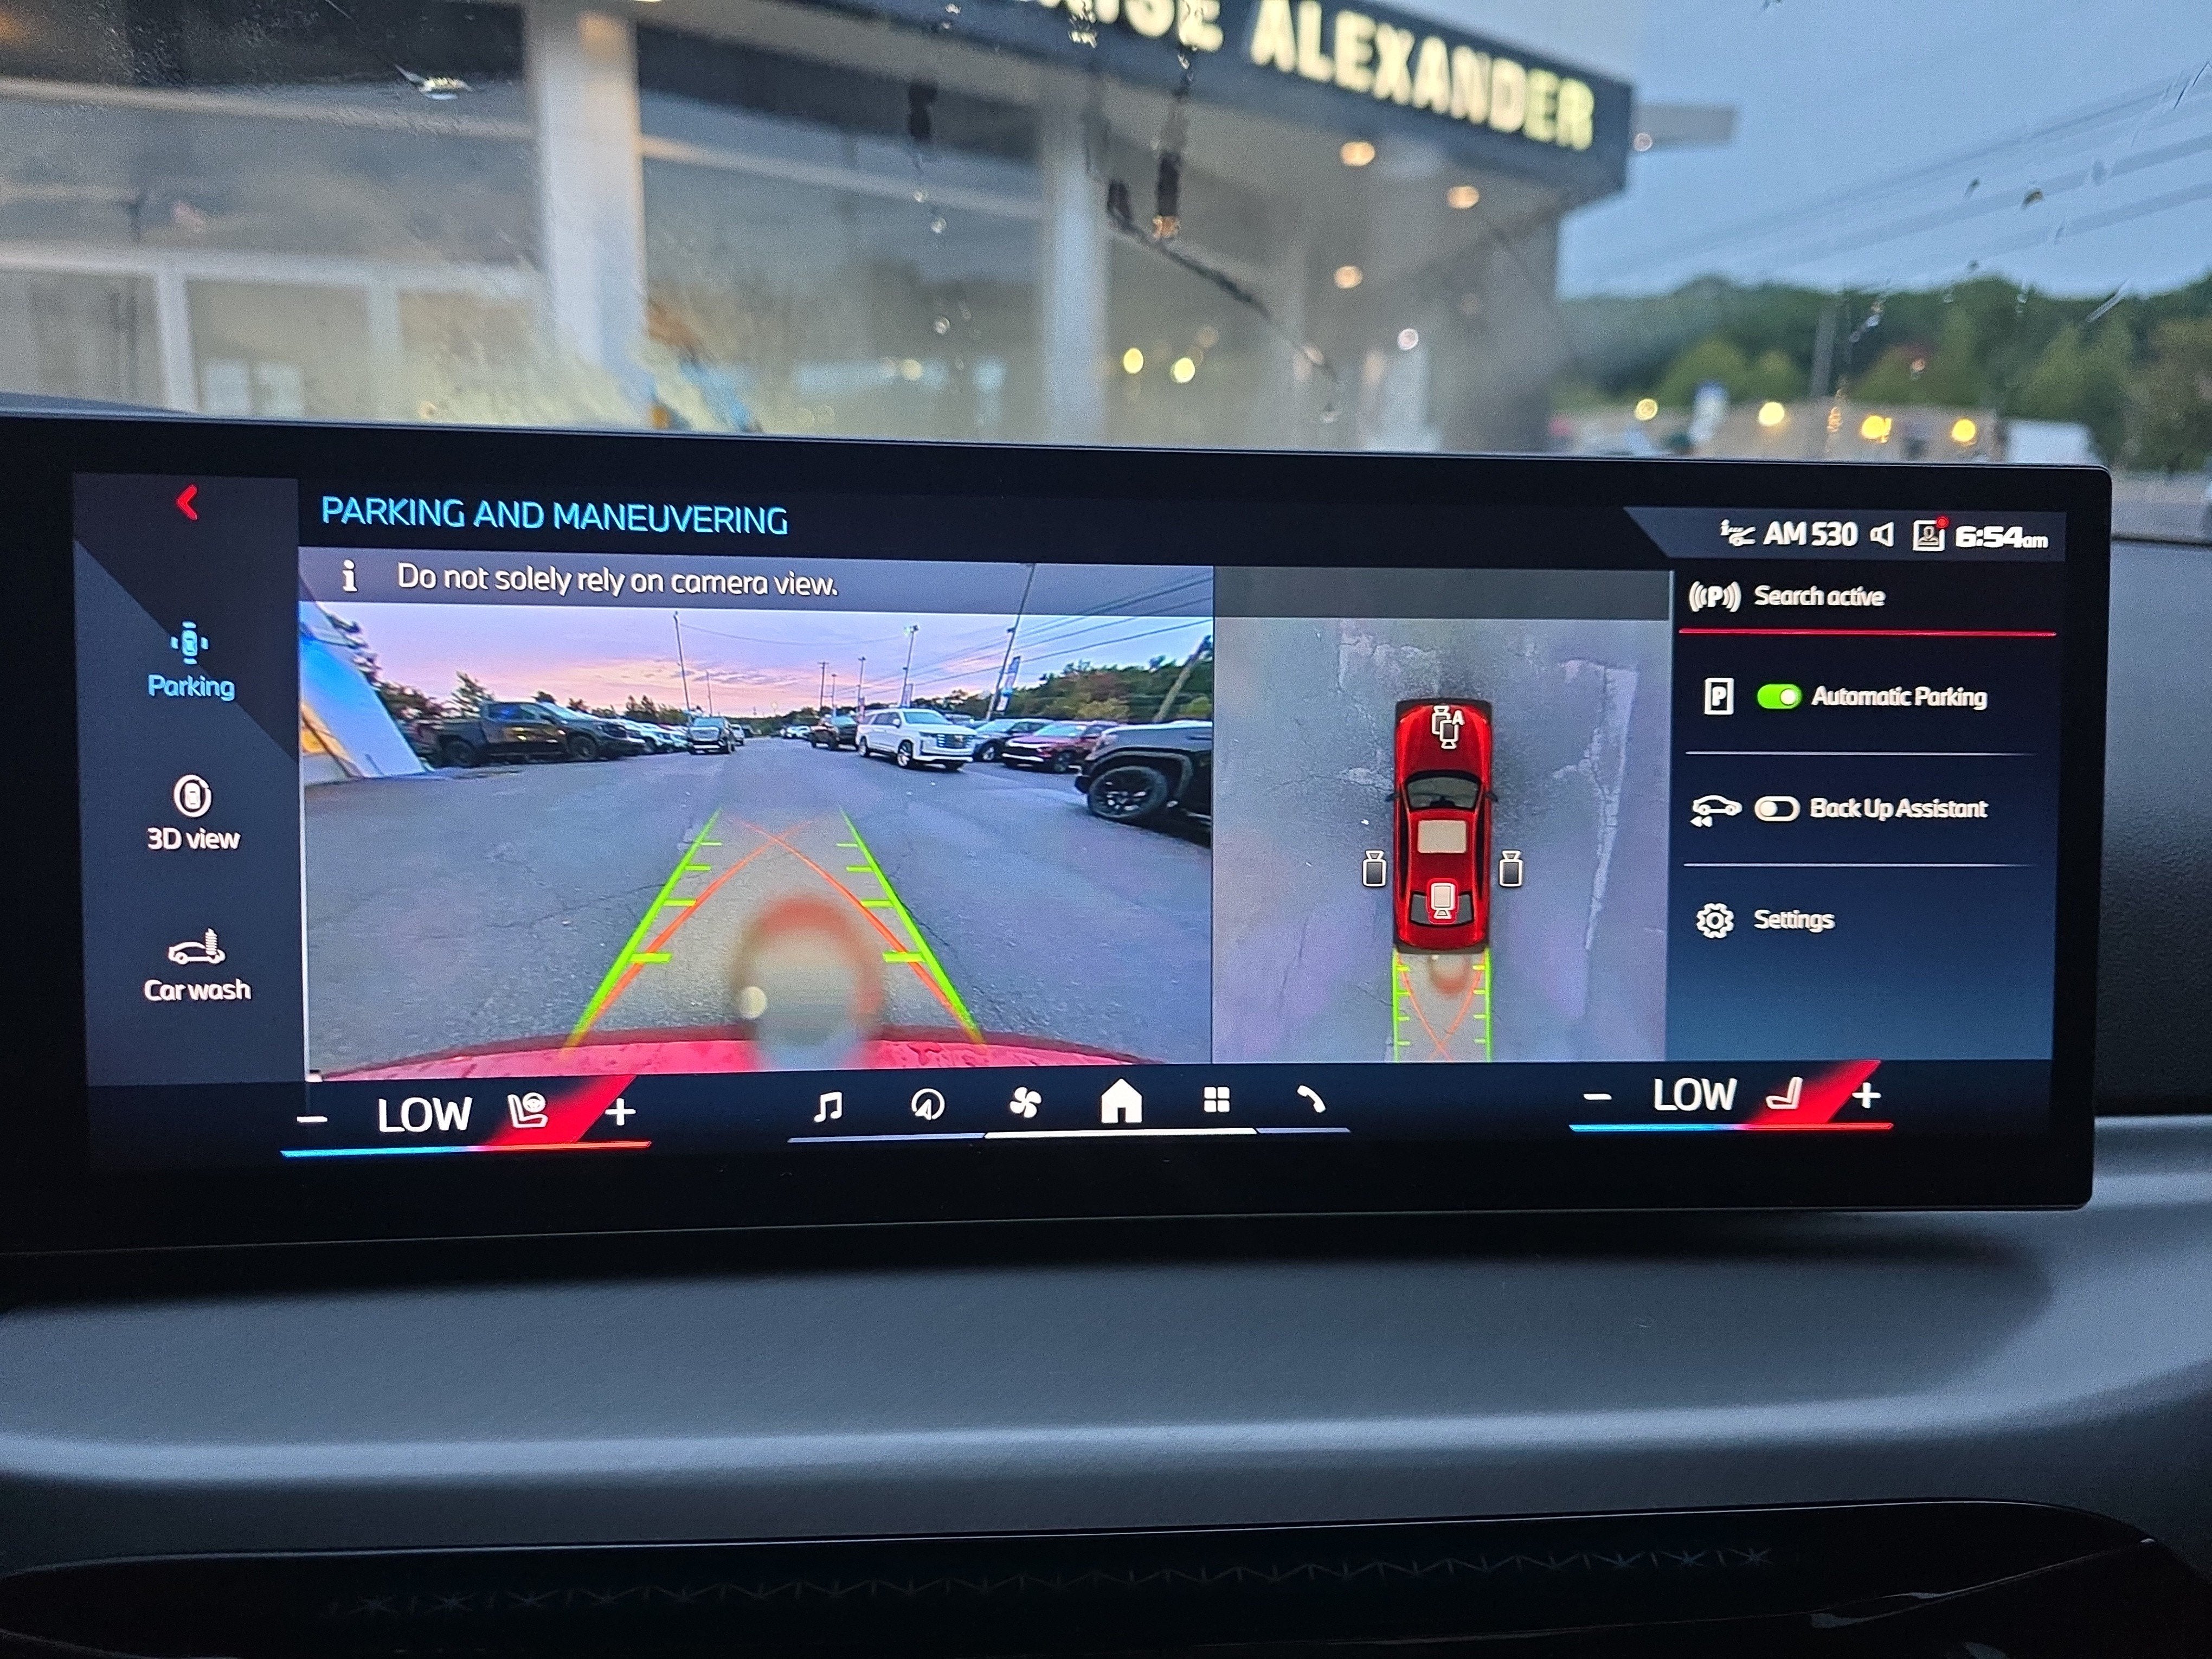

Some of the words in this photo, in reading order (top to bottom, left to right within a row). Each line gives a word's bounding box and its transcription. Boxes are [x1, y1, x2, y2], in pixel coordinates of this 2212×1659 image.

[1250, 0, 1595, 151] ALEXANDER
[322, 496, 465, 528] PARKING
[473, 499, 545, 529] AND
[553, 502, 788, 536] MANEUVERING
[1763, 520, 1807, 546] AM
[1811, 521, 1859, 547] 530
[397, 562, 436, 589] Do
[443, 567, 489, 590] not
[494, 564, 573, 596] solely
[577, 566, 626, 597] rely
[631, 573, 664, 593] on
[671, 574, 768, 595] camera
[773, 570, 838, 596] view.
[1754, 584, 1824, 606] Search
[1827, 586, 1887, 607] active
[147, 673, 235, 702] Parking
[1811, 685, 1912, 706] Automatic
[1914, 686, 1989, 711] Parking
[1810, 798, 1861, 818] Back
[1864, 798, 1894, 822] Up
[1895, 798, 1989, 818] Assistant
[147, 827, 182, 850] 3D
[185, 827, 241, 850] view
[1753, 909, 1836, 933] Settings
[144, 979, 184, 1001] Car
[184, 978, 252, 1001] wash
[1654, 1077, 1738, 1112] LOW
[378, 1096, 473, 1133] LOW
